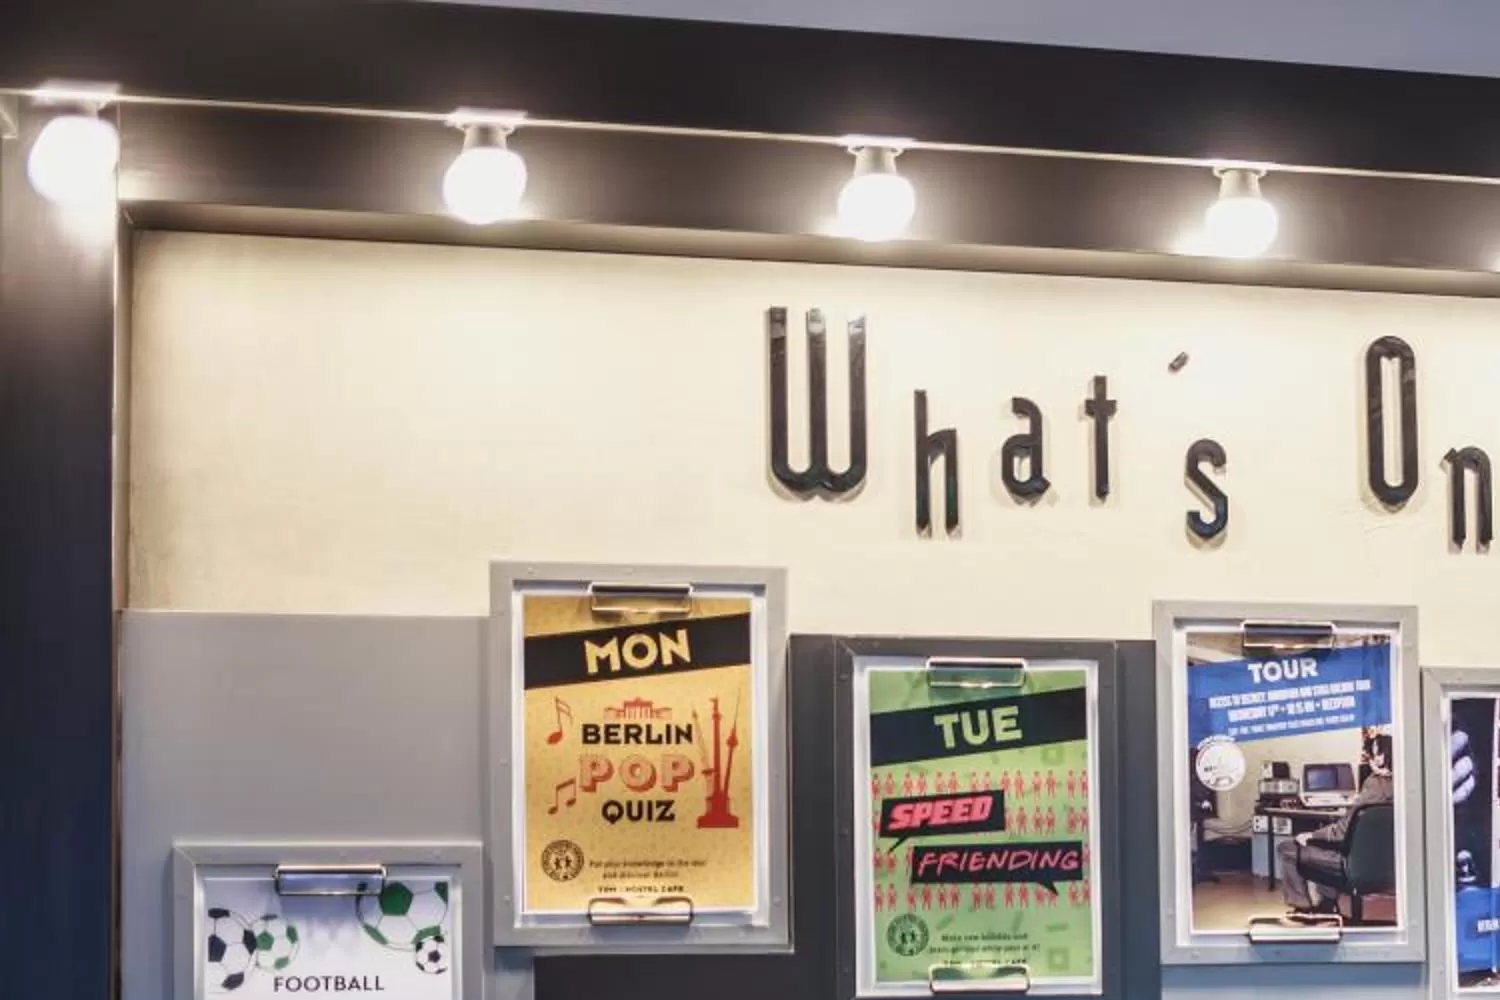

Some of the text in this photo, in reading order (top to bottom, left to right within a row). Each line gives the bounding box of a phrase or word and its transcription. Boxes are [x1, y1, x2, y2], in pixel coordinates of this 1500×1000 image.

[1365, 335, 1494, 553] On
[584, 629, 690, 674] MON
[1248, 657, 1319, 684] TOUR
[581, 723, 693, 745] BERLIN
[934, 705, 1023, 749] TUE
[579, 754, 695, 794] POP
[602, 799, 676, 824] QUIZ
[889, 795, 994, 832] SPEED
[917, 848, 1080, 877] FRIENDING
[273, 975, 384, 992] FOOTBALL
